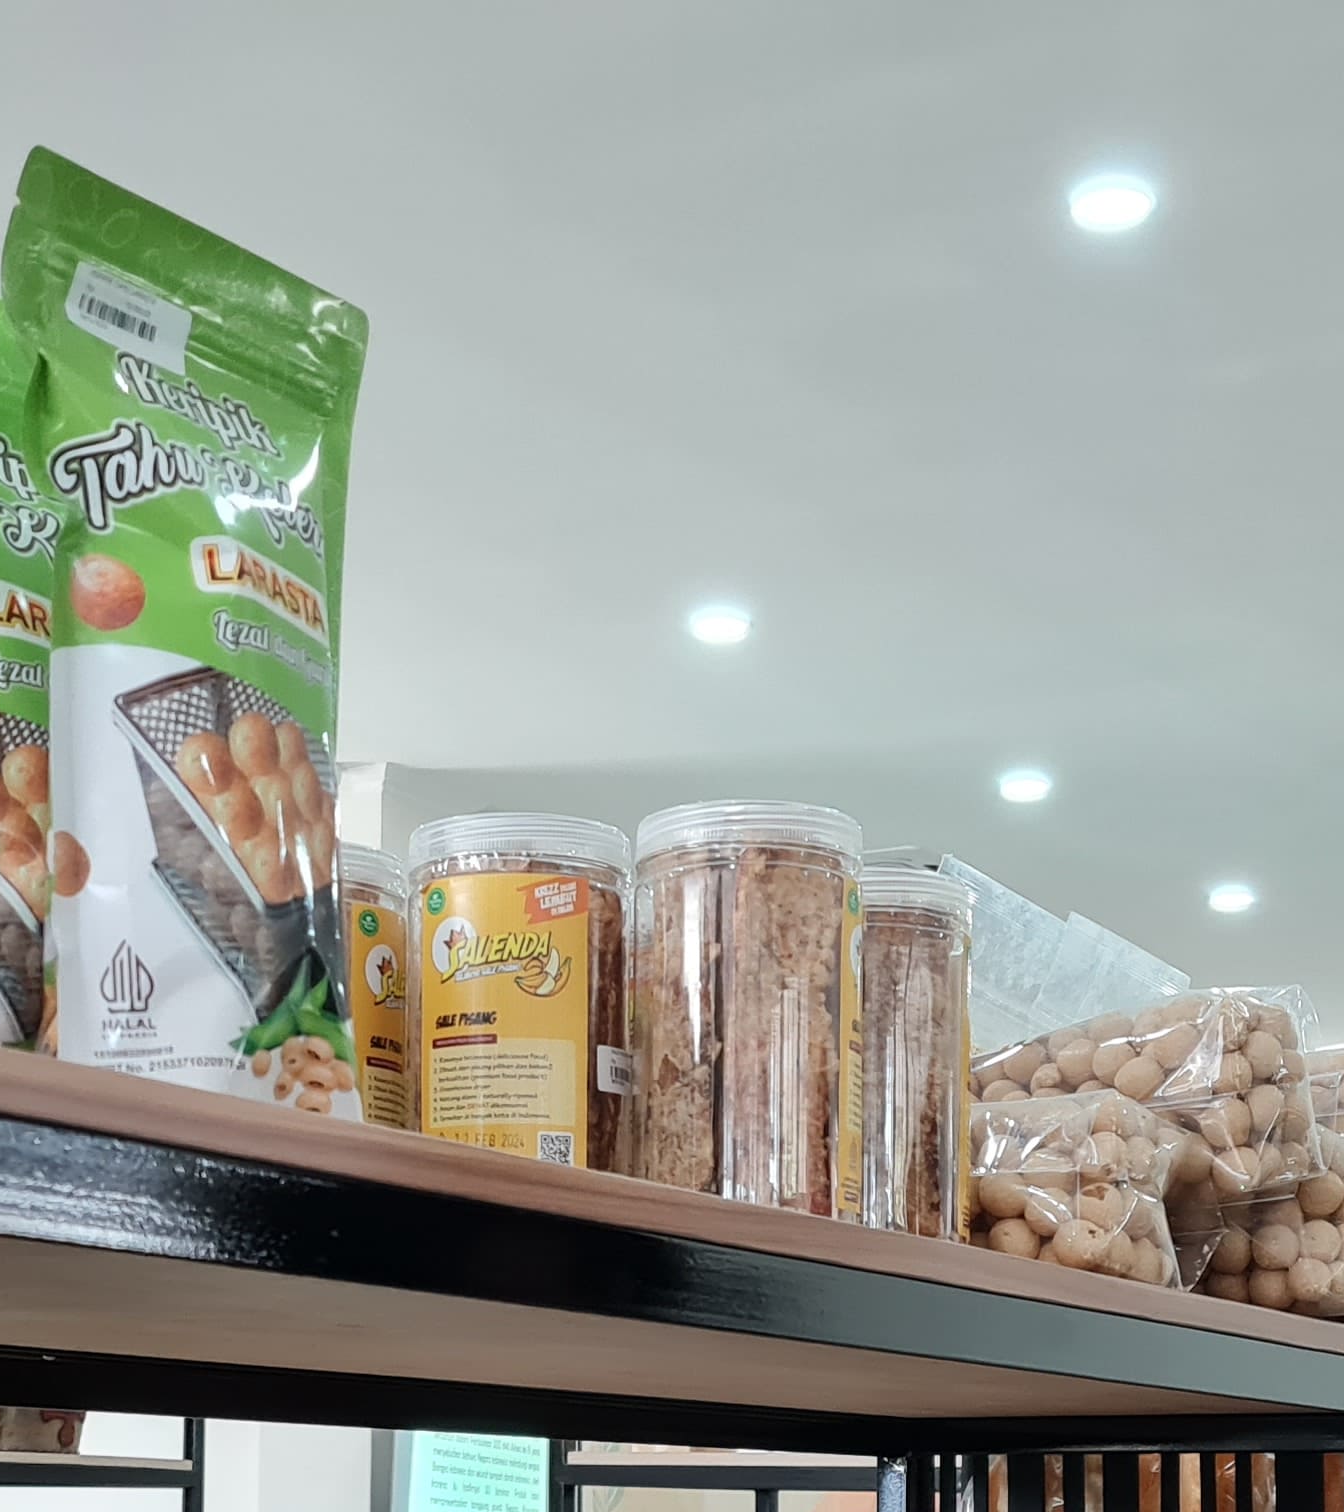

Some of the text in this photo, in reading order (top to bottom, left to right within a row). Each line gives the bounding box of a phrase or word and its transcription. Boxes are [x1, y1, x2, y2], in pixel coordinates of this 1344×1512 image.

[116, 350, 282, 458] Keripik
[51, 421, 204, 531] Tahu
[202, 543, 326, 633] LARASTA
[441, 931, 552, 984] SALENDA
[435, 1014, 457, 1030] SALE
[474, 1134, 496, 1147] FEB
